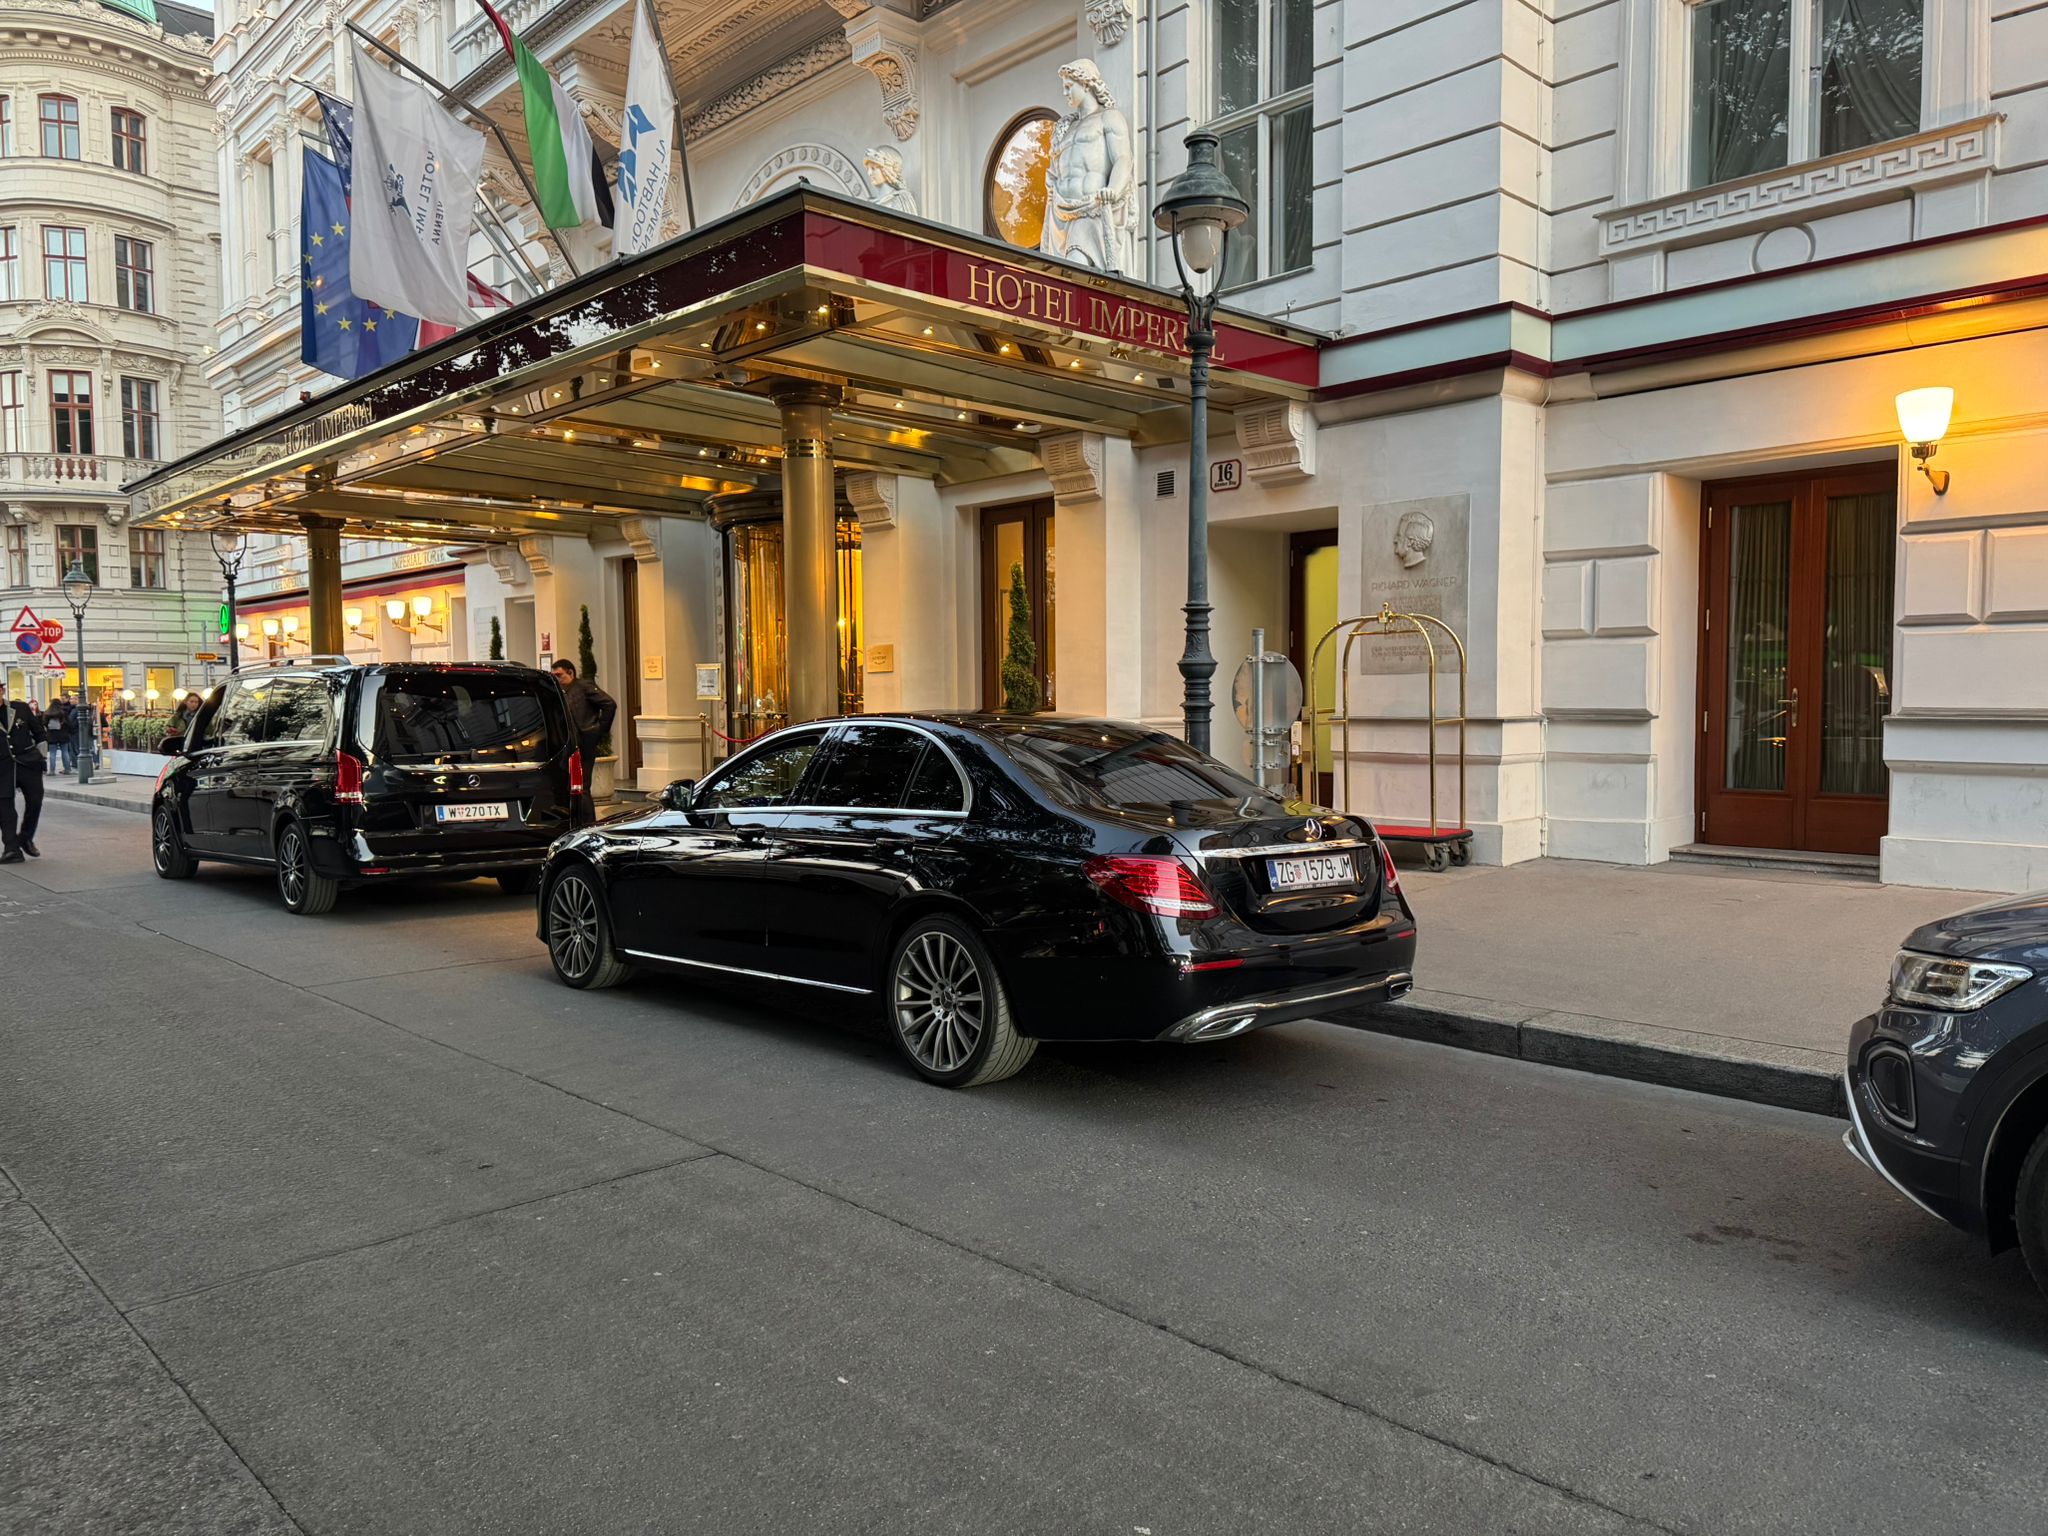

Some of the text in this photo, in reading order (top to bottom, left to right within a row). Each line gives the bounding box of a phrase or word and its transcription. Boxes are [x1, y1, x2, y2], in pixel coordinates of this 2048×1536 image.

[967, 264, 1225, 361] HOTEL IMPERIL
[284, 400, 377, 456] HOTEL IMPERIAL
[1218, 463, 1232, 482] 16
[1371, 576, 1457, 592] RICHARD WAGNER
[448, 807, 457, 818] W
[487, 805, 501, 816] TX
[1277, 861, 1295, 884] ZG
